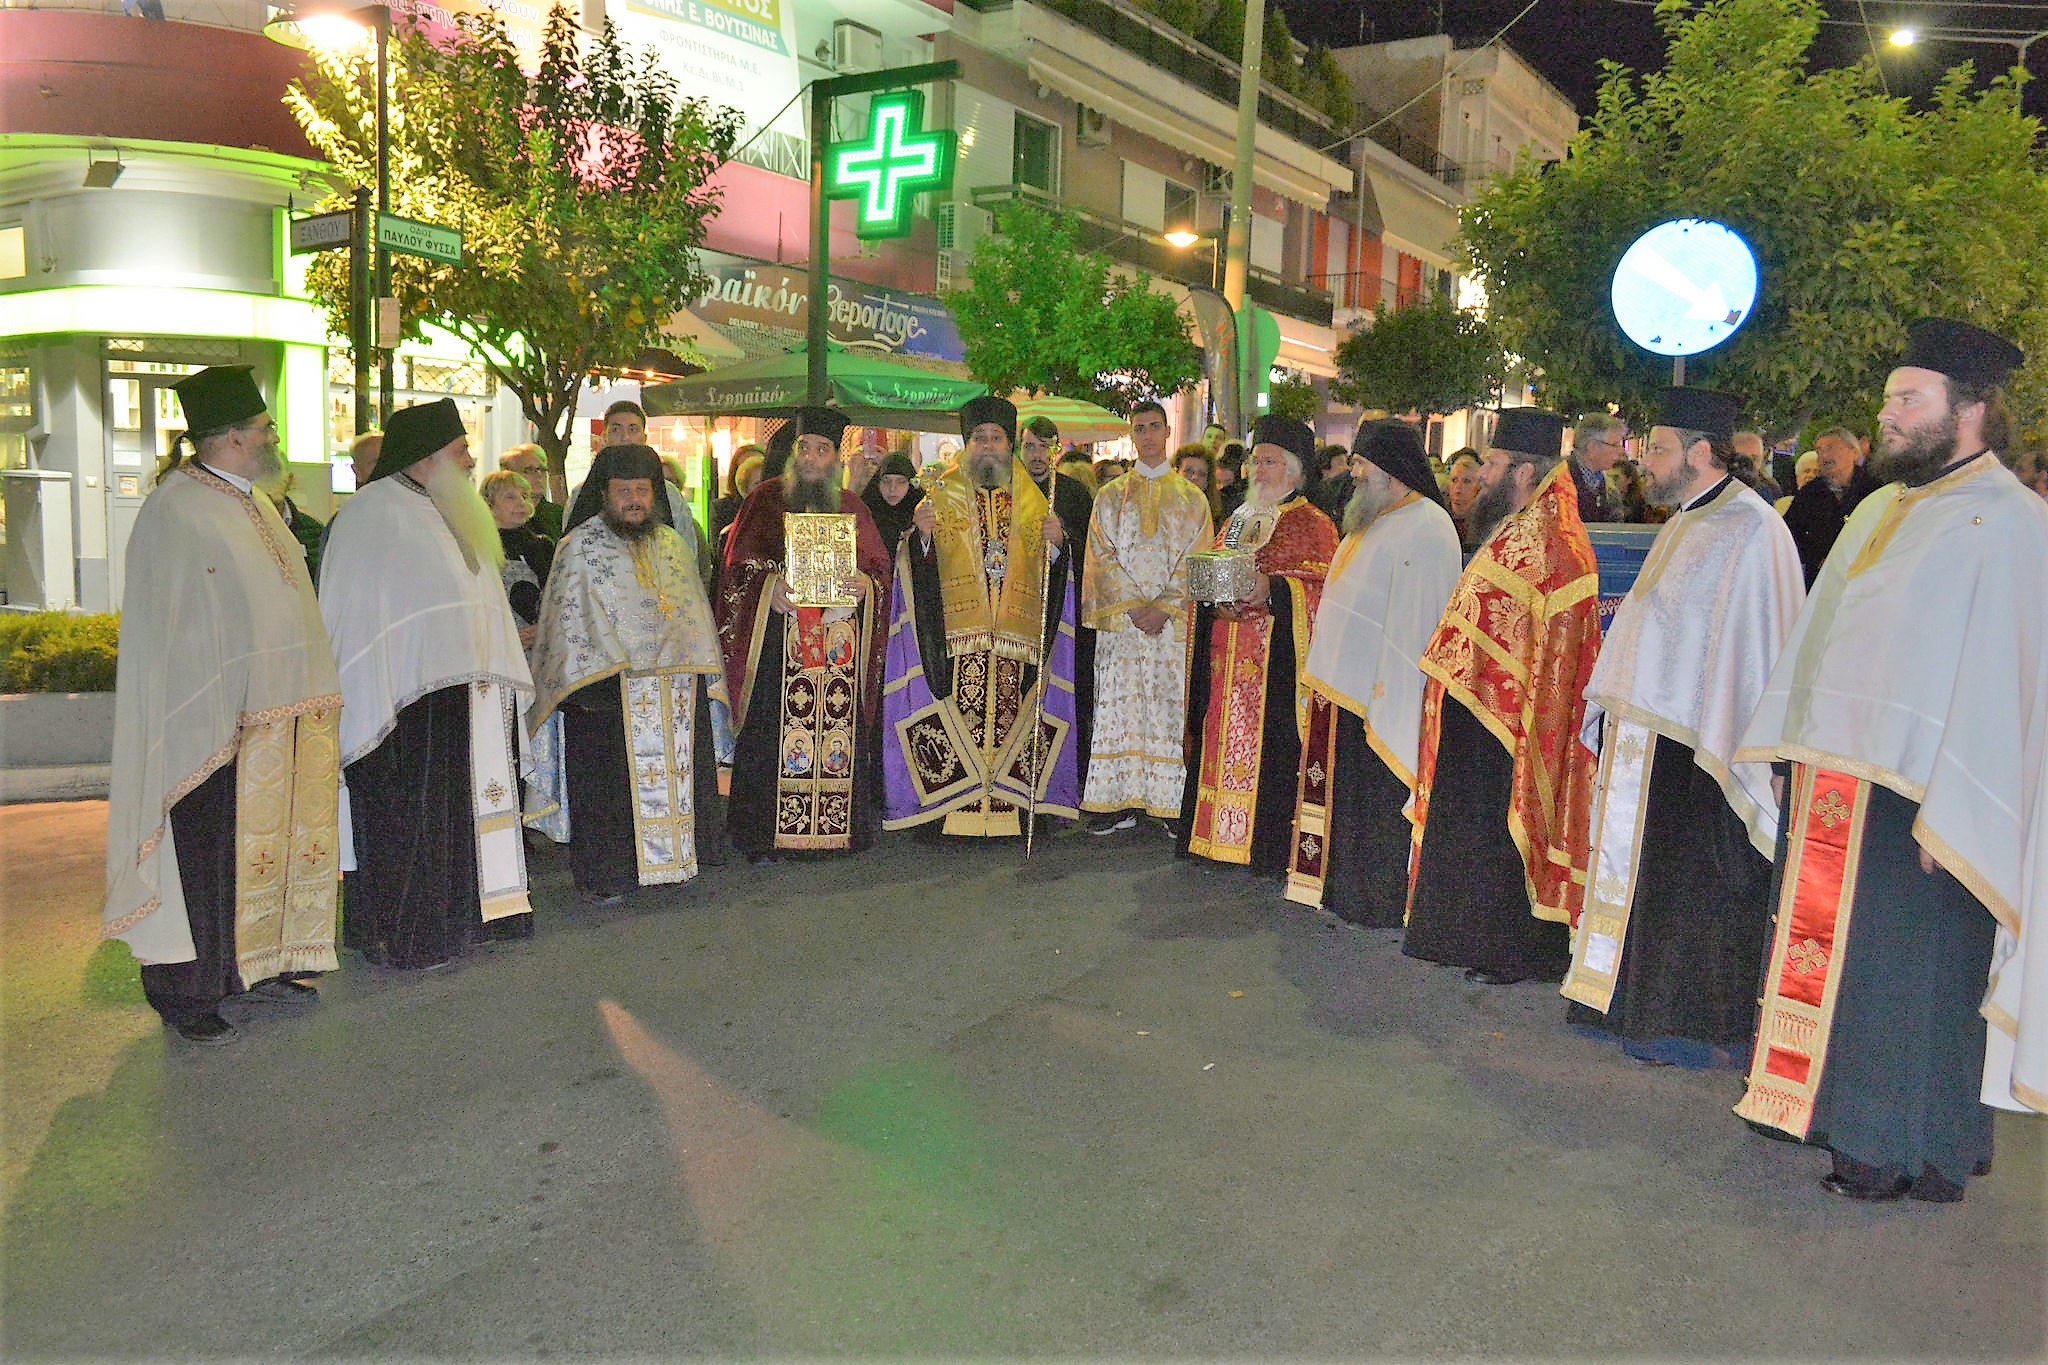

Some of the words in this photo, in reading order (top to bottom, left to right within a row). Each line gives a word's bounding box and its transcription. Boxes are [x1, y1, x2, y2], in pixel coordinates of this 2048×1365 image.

[705, 8, 778, 49] ΒΟΥΤΣΙΝΑΣ
[659, 29, 738, 67] ΦΡΟΝΤΙΣΤΗΡΙΑ
[301, 219, 341, 242] ΞΑΝΘΟΥ
[384, 229, 423, 248] ΠΑΥΛΟΥ
[425, 239, 457, 256] ΦΥΣΣΑ
[409, 225, 432, 238] ΟΔΟΣ
[699, 269, 808, 316] ραϊκόν
